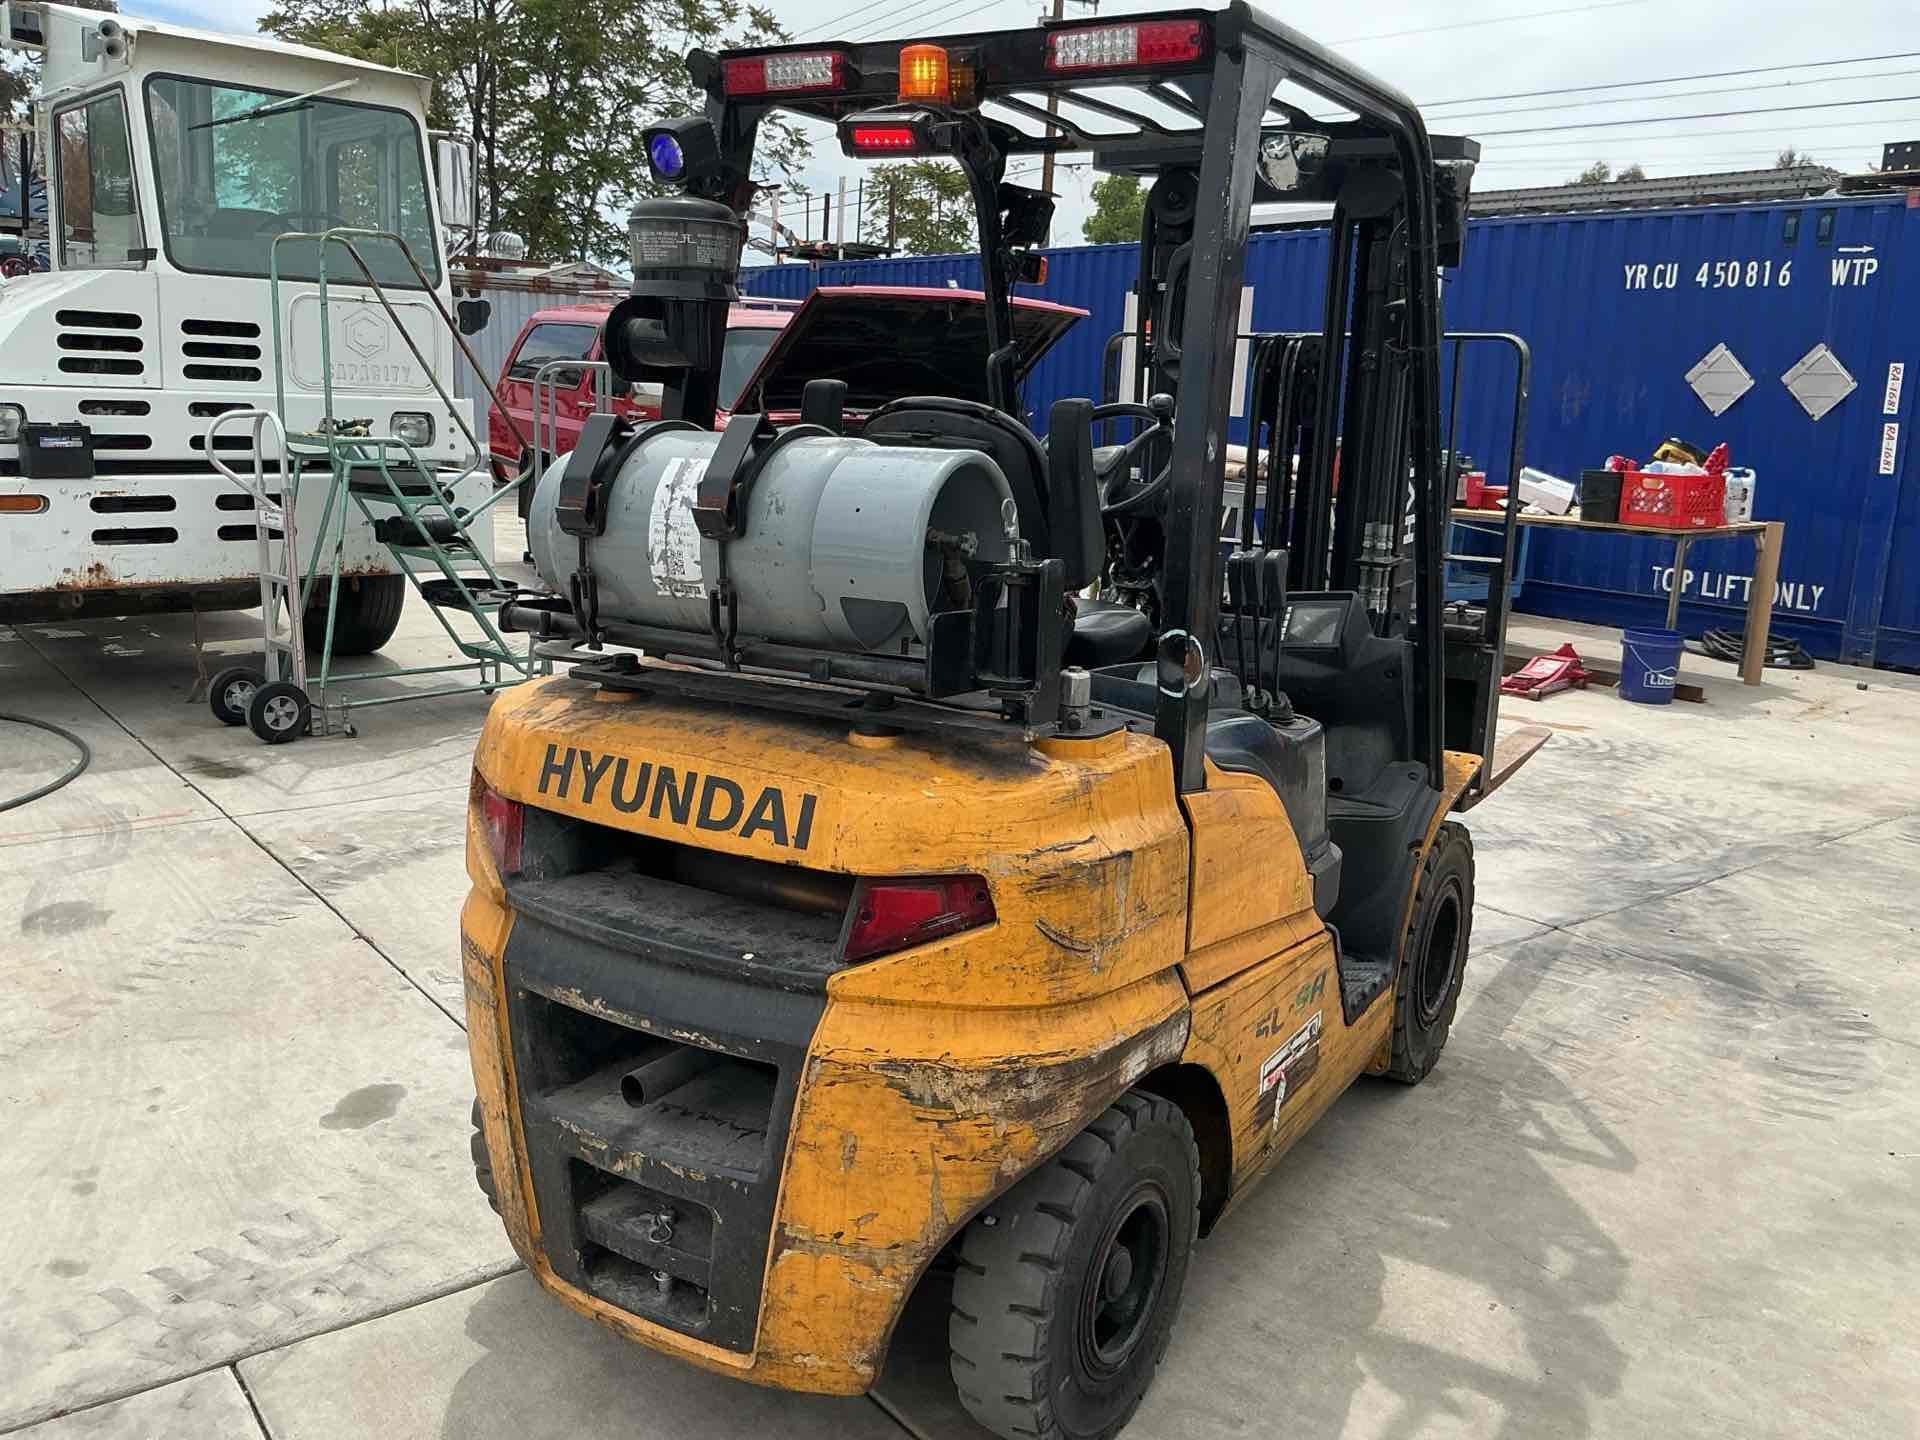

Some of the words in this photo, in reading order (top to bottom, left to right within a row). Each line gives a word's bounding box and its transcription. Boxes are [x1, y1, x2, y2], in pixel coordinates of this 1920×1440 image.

[1623, 263, 1680, 290] YRCU
[1695, 260, 1793, 288] 450816
[1830, 258, 1879, 286] WTP
[1701, 572, 1753, 602] LIFT
[537, 743, 818, 851] HYUNDAI
